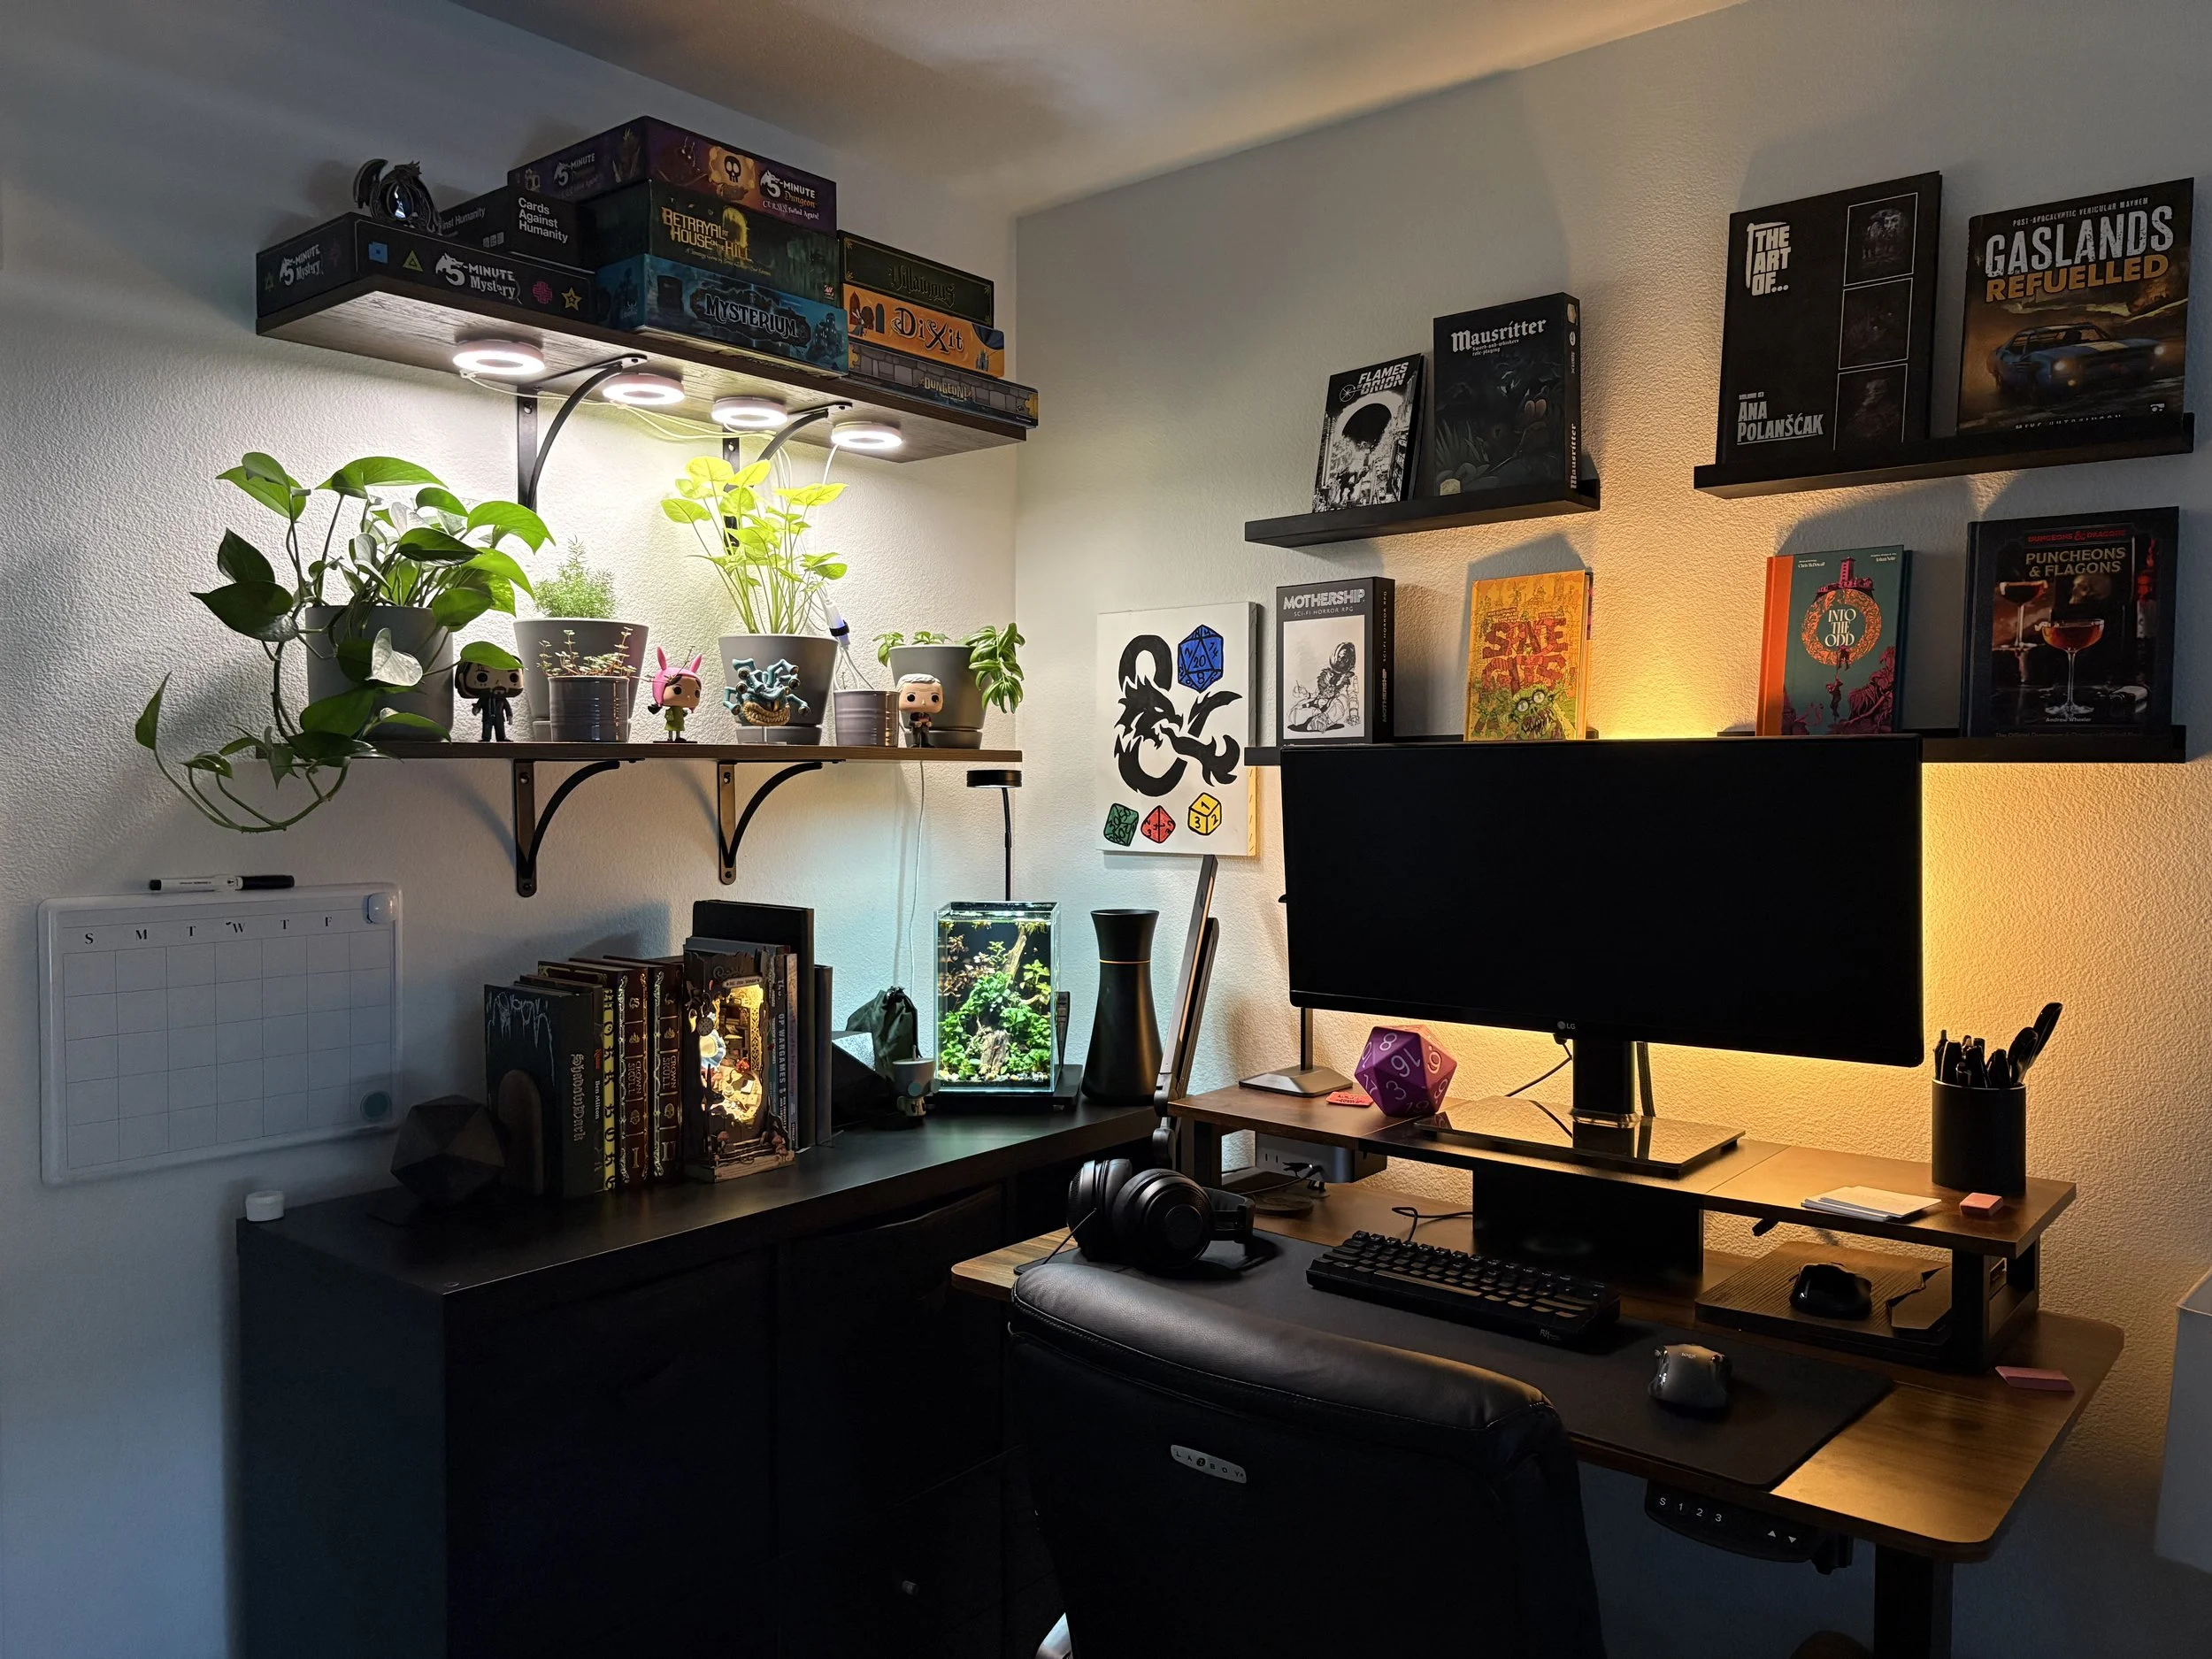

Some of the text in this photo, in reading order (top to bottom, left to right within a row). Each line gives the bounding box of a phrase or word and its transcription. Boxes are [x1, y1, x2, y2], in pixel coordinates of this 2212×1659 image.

[760, 170, 816, 198] 5-MINUTE
[518, 197, 550, 214] Cards
[784, 191, 816, 208] Dungeon
[2079, 202, 2116, 216] VEHICULAR
[2119, 196, 2149, 210] MAYHEM
[456, 206, 487, 227] Humanity
[518, 211, 558, 228] Against
[662, 206, 726, 240] BETRAYAL
[518, 220, 568, 243] Humanity
[1755, 225, 1790, 252] THE
[1984, 204, 2174, 279] GASLANDS
[670, 226, 714, 250] HOUSE
[725, 240, 752, 262] HILL
[280, 243, 321, 286] 5-MINUTE
[296, 261, 321, 280] Mystery
[435, 252, 516, 286] 5-MINUTE
[1753, 247, 1792, 274] ART
[471, 277, 518, 299] Mystery
[888, 265, 955, 308] Villainous
[1752, 271, 1789, 296] OF...
[1985, 254, 2170, 303] REFUELLED
[704, 294, 798, 338] MYSTERIUM
[1451, 319, 1547, 353] Mausritter
[1358, 361, 1409, 384] FLAMES
[1361, 373, 1406, 396] ORION
[1738, 400, 1768, 422] ANA
[1737, 411, 1824, 443] POLANŠĆAK
[2027, 534, 2073, 542] DUNGEONS
[2025, 547, 2127, 565] PUNCHEONS
[2029, 561, 2122, 578] & FLAGONS
[1283, 588, 1365, 611] MOTHERSHIP
[1828, 608, 1857, 623] INTO
[1831, 621, 1851, 634] THE
[1824, 634, 1855, 648] ODD
[1185, 648, 1193, 658] 2
[1193, 655, 1207, 669] 20
[1197, 672, 1205, 685] 8
[1202, 801, 1210, 810] 1
[1194, 814, 1219, 829] 3 2
[84, 916, 333, 945] S M T W T F
[1379, 1032, 1397, 1051] 8
[777, 1029, 786, 1084] WARGAMES
[1390, 1048, 1422, 1078] 16
[662, 1056, 671, 1090] SKULL
[1385, 1079, 1407, 1101] 3
[1659, 1496, 1723, 1523] S 1 2 3
